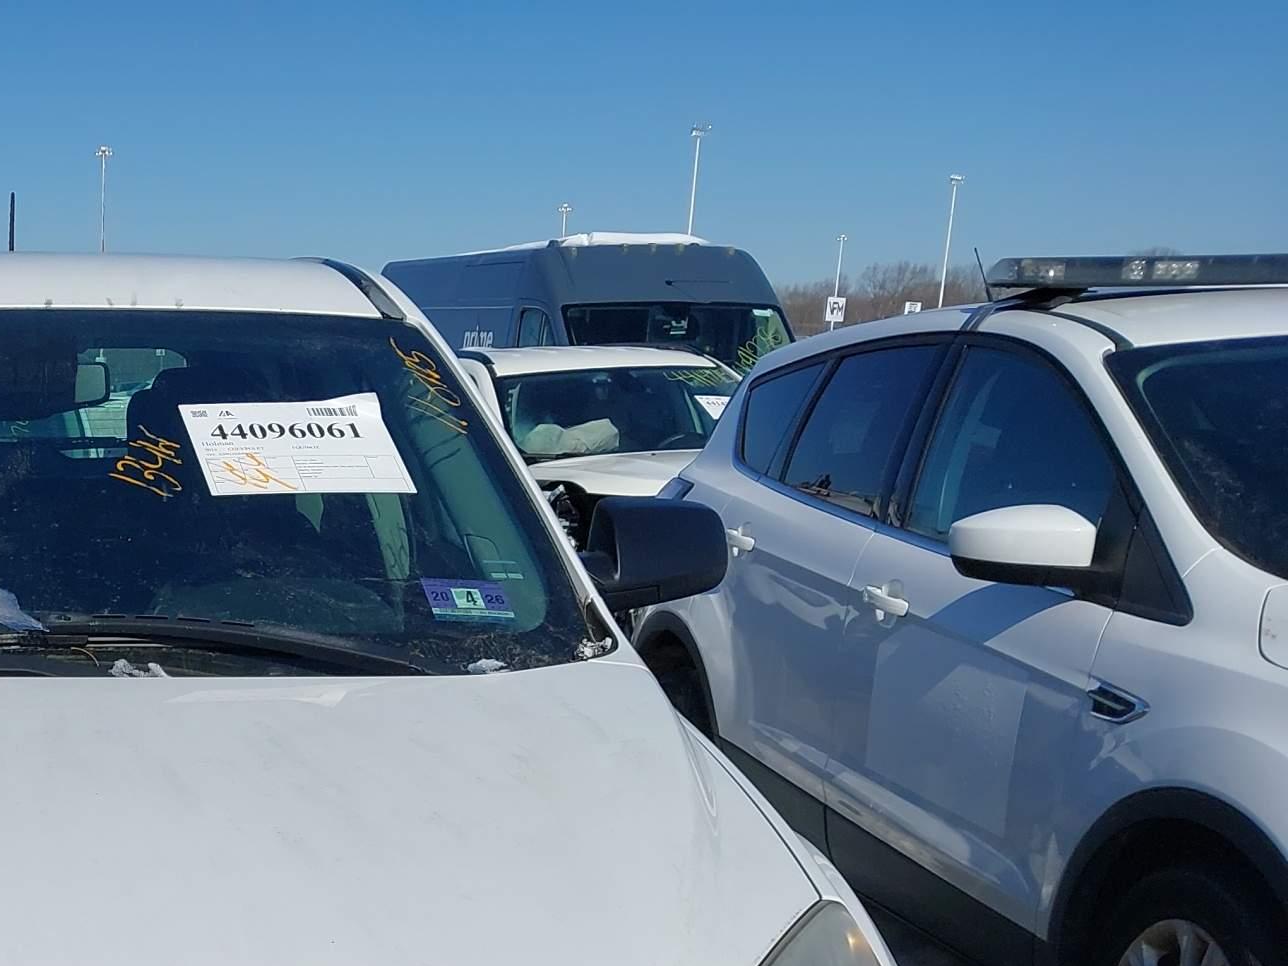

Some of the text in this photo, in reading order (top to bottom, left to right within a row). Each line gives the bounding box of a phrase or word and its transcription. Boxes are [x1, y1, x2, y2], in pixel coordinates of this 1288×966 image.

[210, 421, 364, 440] 44096061
[431, 590, 506, 606] 20 4 26
